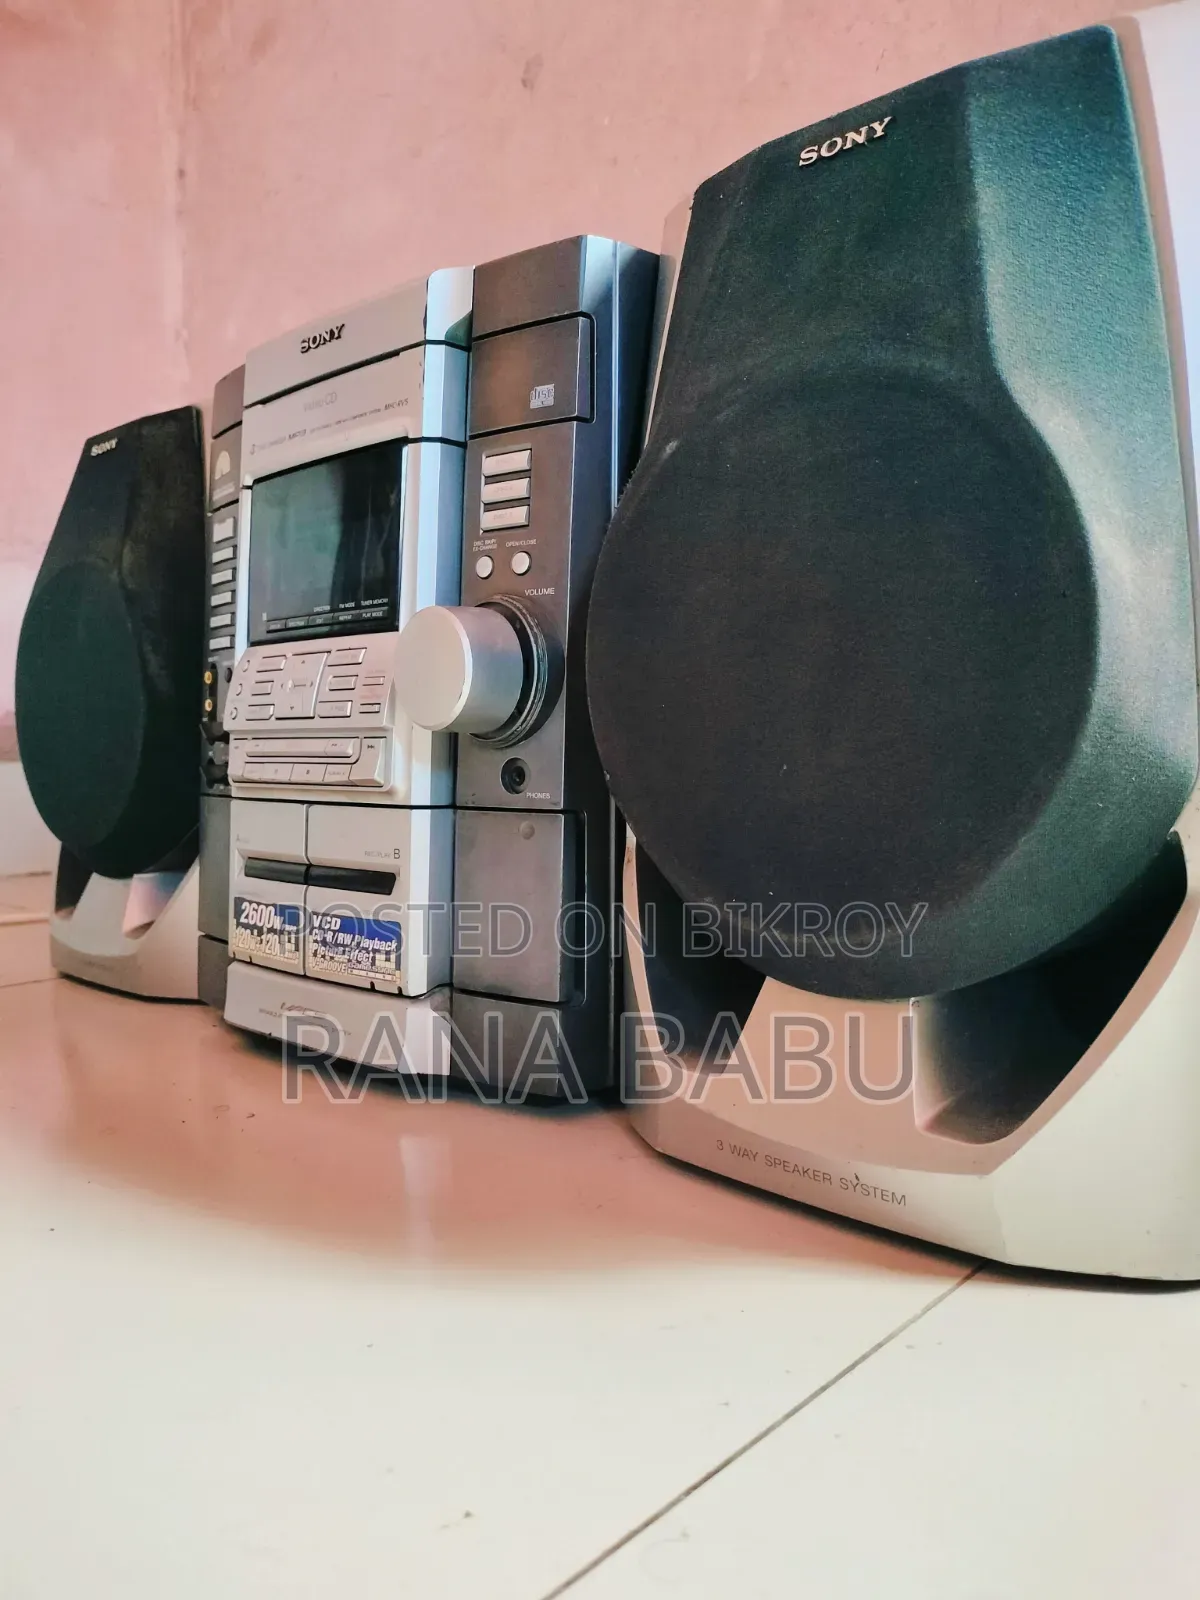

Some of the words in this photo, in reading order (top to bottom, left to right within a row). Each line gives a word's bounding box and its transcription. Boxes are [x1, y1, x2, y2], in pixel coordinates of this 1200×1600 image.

[799, 116, 892, 166] SONY
[300, 323, 345, 353] SONY
[90, 438, 118, 456] SONY
[524, 587, 556, 596] VOLUME
[393, 848, 401, 860] B
[312, 914, 341, 931] VCD
[312, 942, 345, 959] Picture
[345, 947, 373, 962] Effect
[353, 934, 398, 952] Playback
[716, 1139, 724, 1151] 3
[728, 1143, 759, 1162] WAY
[764, 1154, 833, 1186] SPEAKER
[839, 1176, 907, 1206] SYSTEM
